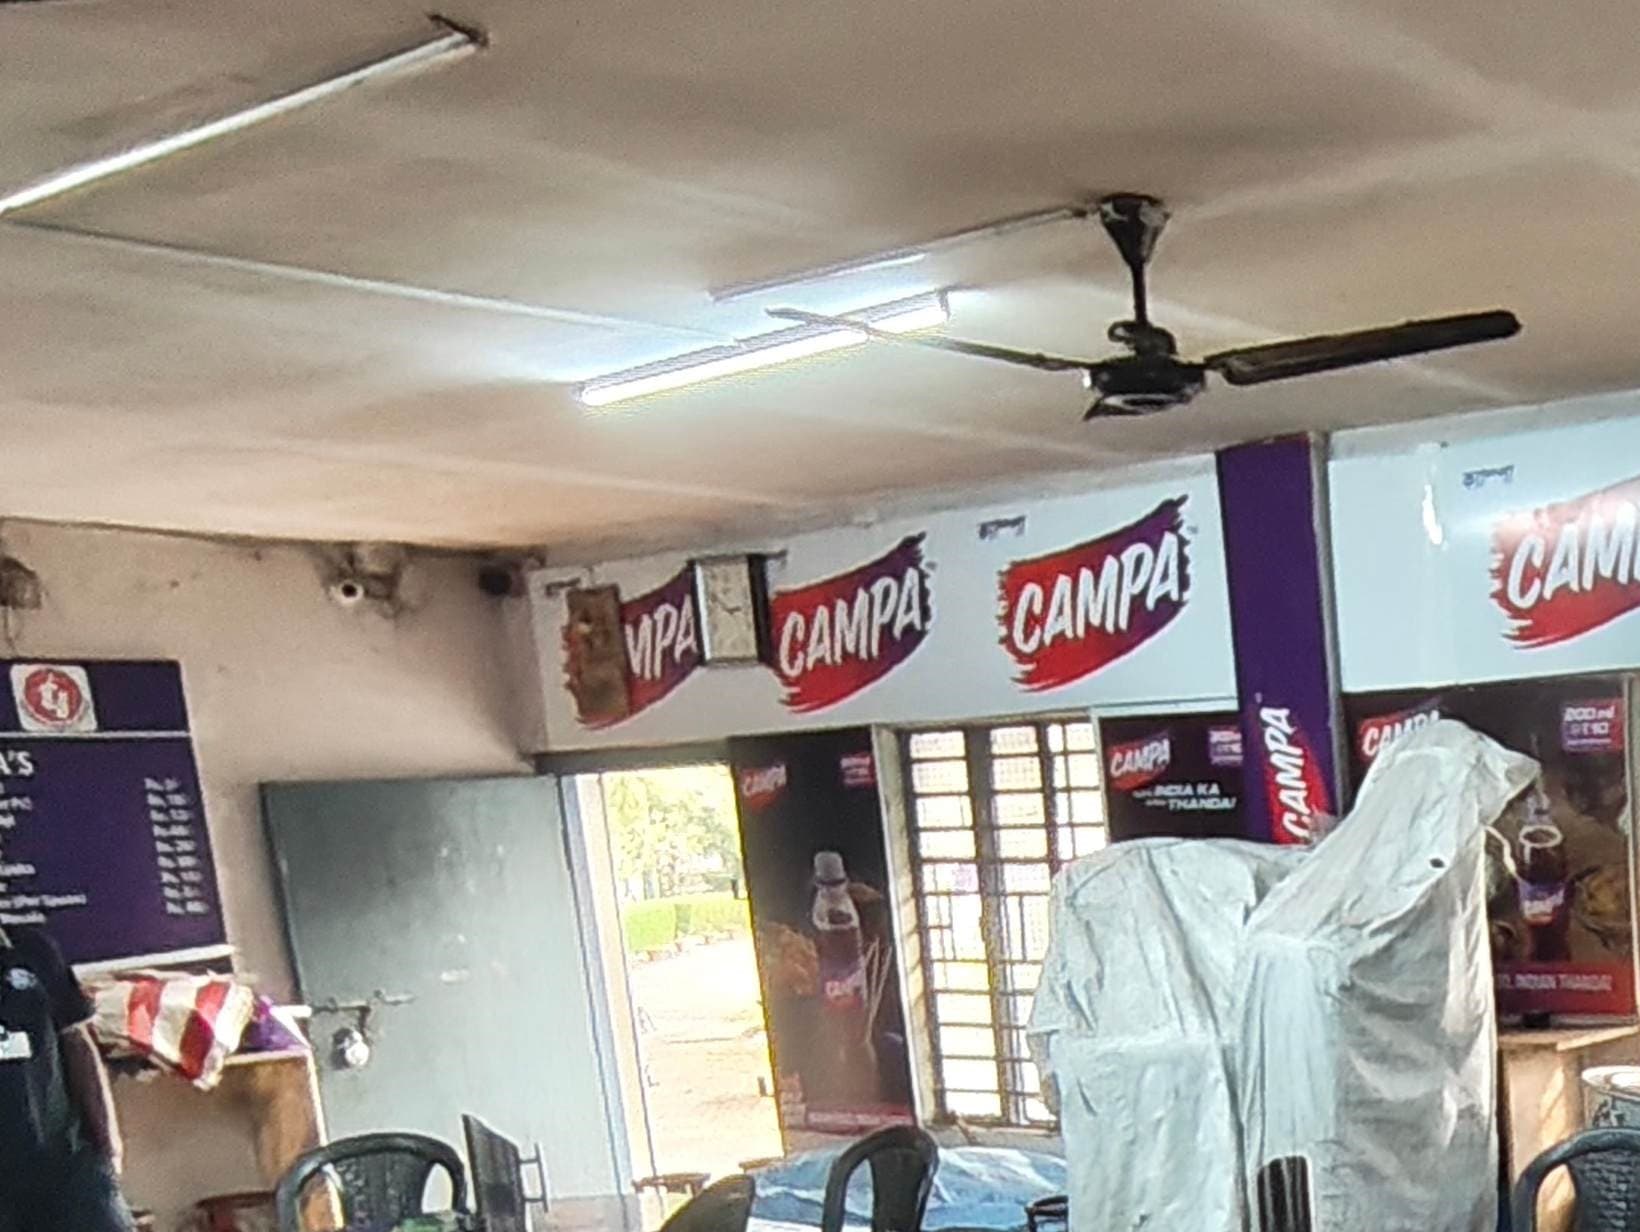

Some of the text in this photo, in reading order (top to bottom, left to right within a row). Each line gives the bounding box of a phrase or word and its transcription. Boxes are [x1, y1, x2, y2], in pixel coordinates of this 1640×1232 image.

[625, 594, 697, 680] MPA
[779, 567, 922, 677] CAMPA
[1012, 532, 1180, 655] CAMPA
[1110, 738, 1171, 777] CAMPA
[1260, 707, 1313, 840] CAMPA
